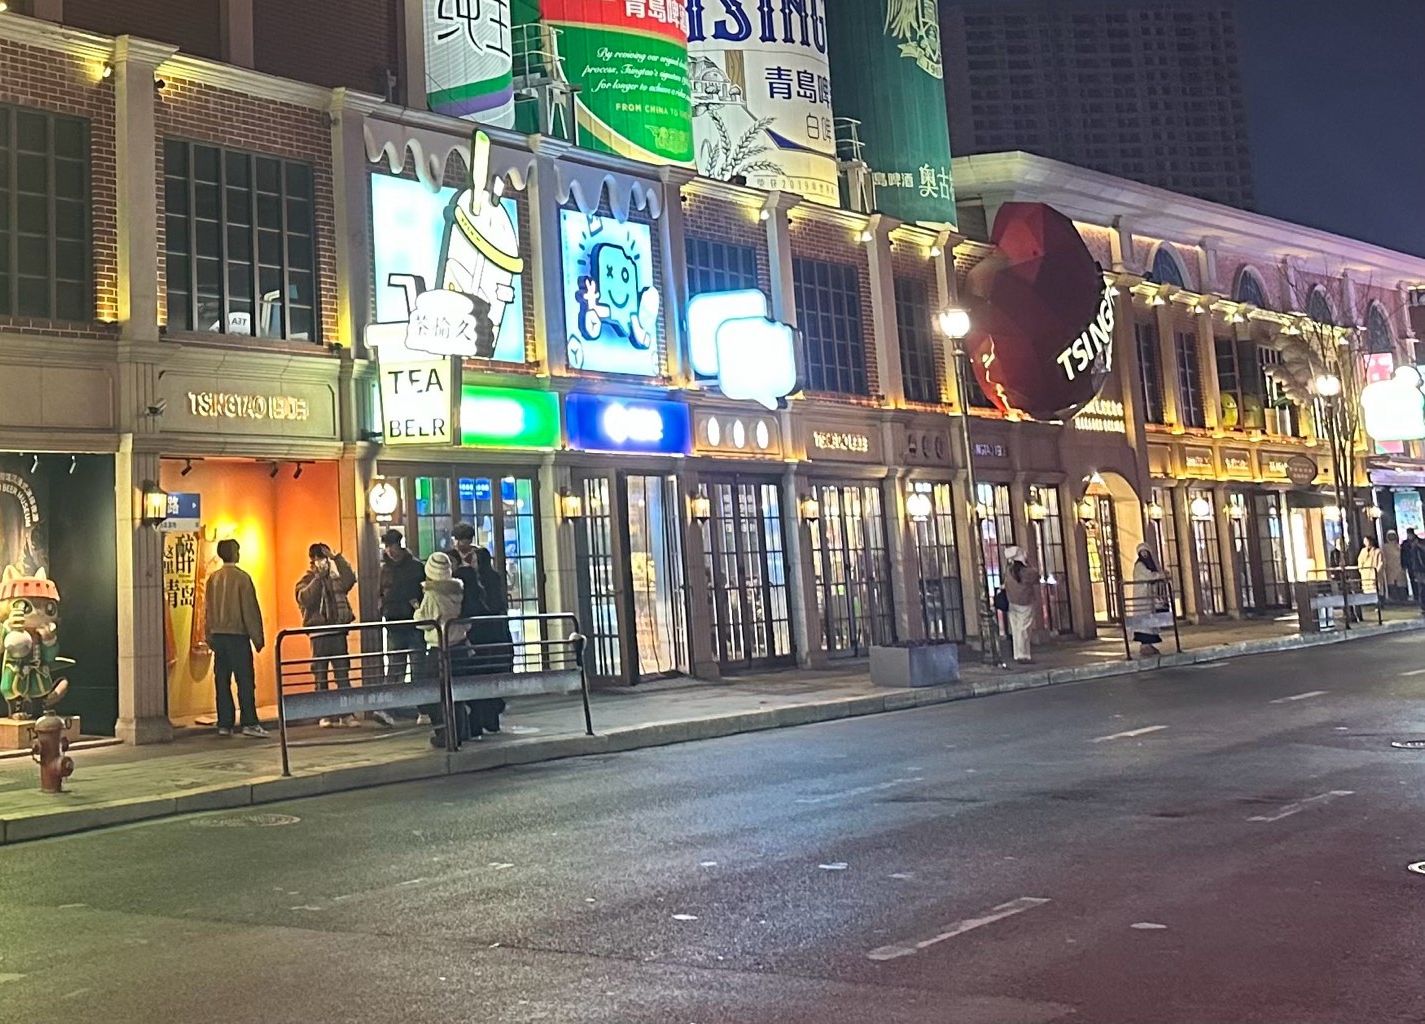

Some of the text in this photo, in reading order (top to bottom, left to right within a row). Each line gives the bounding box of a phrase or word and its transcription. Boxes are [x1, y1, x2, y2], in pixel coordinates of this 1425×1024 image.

[597, 47, 613, 61] By
[591, 78, 612, 93] for
[615, 102, 642, 112] FROM
[644, 104, 668, 115] CHINA
[388, 367, 444, 395] TEA
[187, 391, 267, 419] TSINGTAO
[2, 483, 18, 496] BEER
